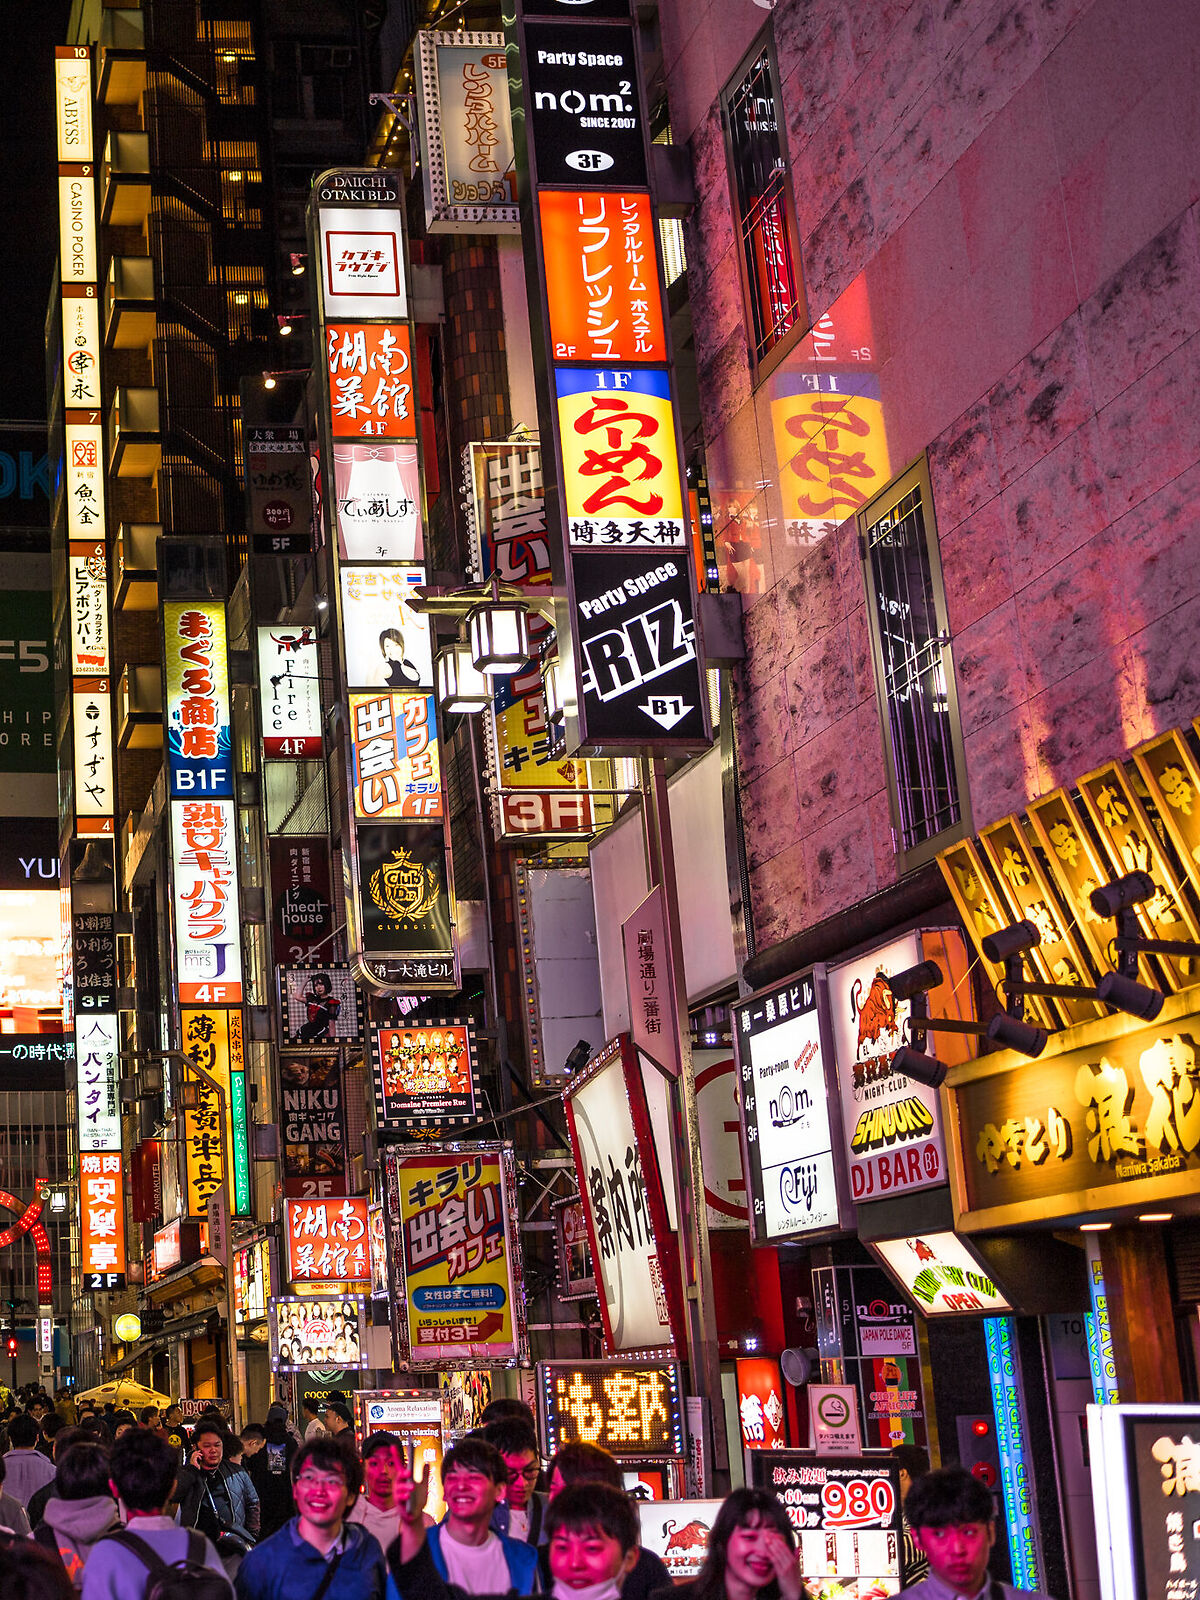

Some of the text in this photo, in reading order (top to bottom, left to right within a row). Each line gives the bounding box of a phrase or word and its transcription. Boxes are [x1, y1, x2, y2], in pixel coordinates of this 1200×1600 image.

[73, 47, 87, 58] 10
[487, 57, 506, 68] 5F
[538, 51, 623, 67] Party Space
[64, 97, 79, 145] ABYSS
[580, 116, 636, 129] SINCE 2007
[82, 165, 90, 175] 9
[577, 154, 602, 169] 3F
[334, 177, 386, 188] DAIICHI
[69, 182, 84, 276] CASINO POKER
[341, 250, 385, 261] カブキ
[335, 262, 391, 273] ラウンジ
[620, 197, 653, 353] レンタルルーム ホステル
[577, 197, 622, 359] リフレッシュ
[85, 287, 94, 297] 8
[328, 329, 409, 376] 湖南
[556, 343, 576, 356] 2F
[71, 351, 95, 400] 幸永
[596, 371, 632, 391] 1F
[332, 375, 411, 420] 菜館
[88, 412, 97, 424] 7
[359, 421, 388, 435] 4F
[573, 396, 664, 516] らーめん
[74, 483, 100, 524] 魚金
[571, 522, 680, 545] 博多天神
[94, 544, 103, 556] 6
[272, 538, 290, 550] 5F
[375, 545, 388, 557] 3F
[579, 561, 678, 620] Party Space
[93, 590, 104, 644] ダーツ カラオケ
[585, 600, 690, 702] RIZ
[98, 679, 106, 692] 5
[179, 611, 218, 758] まぐろ商店
[284, 659, 298, 721] Fire
[652, 700, 682, 716] B1
[280, 738, 306, 755] 4F
[403, 697, 433, 781] カフェ
[356, 698, 400, 815] 出会い
[84, 726, 106, 808] すずや
[175, 769, 226, 790] B1F
[405, 783, 439, 794] キラリ
[412, 798, 438, 815] 1F
[508, 795, 584, 828] 3F
[179, 803, 234, 940] 熟女キャバクラ
[374, 965, 453, 978] 第一大滝ビル
[637, 930, 662, 1035] 劇場通り一番街
[82, 995, 111, 1009] 3F
[194, 987, 226, 1002] 4F
[741, 981, 814, 1032] 第一桑原ビル
[231, 1016, 243, 1064] 炭火串焼
[743, 1065, 753, 1081] 5F
[82, 1051, 103, 1124] バンタイ
[864, 1082, 888, 1101] NIGHT
[285, 1090, 338, 1111] NIKU
[390, 1101, 420, 1109] Domaine
[769, 1087, 813, 1120] nom.
[851, 1095, 936, 1149] SHINJUKU
[286, 1123, 341, 1143] GANG
[976, 1106, 1074, 1175] やきとり
[91, 1140, 108, 1149] 3F
[82, 1156, 120, 1174] 焼肉
[408, 1156, 484, 1208] キラリ
[852, 1153, 923, 1198] DJ BAR
[153, 1161, 162, 1211] ANRAKUTEI
[302, 1181, 332, 1196] 2F
[291, 1200, 366, 1242] 湖南
[408, 1190, 496, 1268] 出会い
[294, 1243, 350, 1279] 菜館
[447, 1236, 504, 1284] カフェ
[90, 1274, 119, 1289] 2F
[424, 1289, 494, 1302] 女性は全て無料!
[941, 1292, 981, 1311] OPEN
[420, 1327, 480, 1343] 受付3F
[861, 1328, 912, 1342] JAPAN POLE DANCE
[870, 1391, 918, 1401] CHOP LIFE
[873, 1400, 916, 1411] AFRICAN
[773, 1466, 827, 1485] 飲み放題
[822, 1480, 895, 1518] 980
[1015, 1462, 1032, 1516] CLUB
